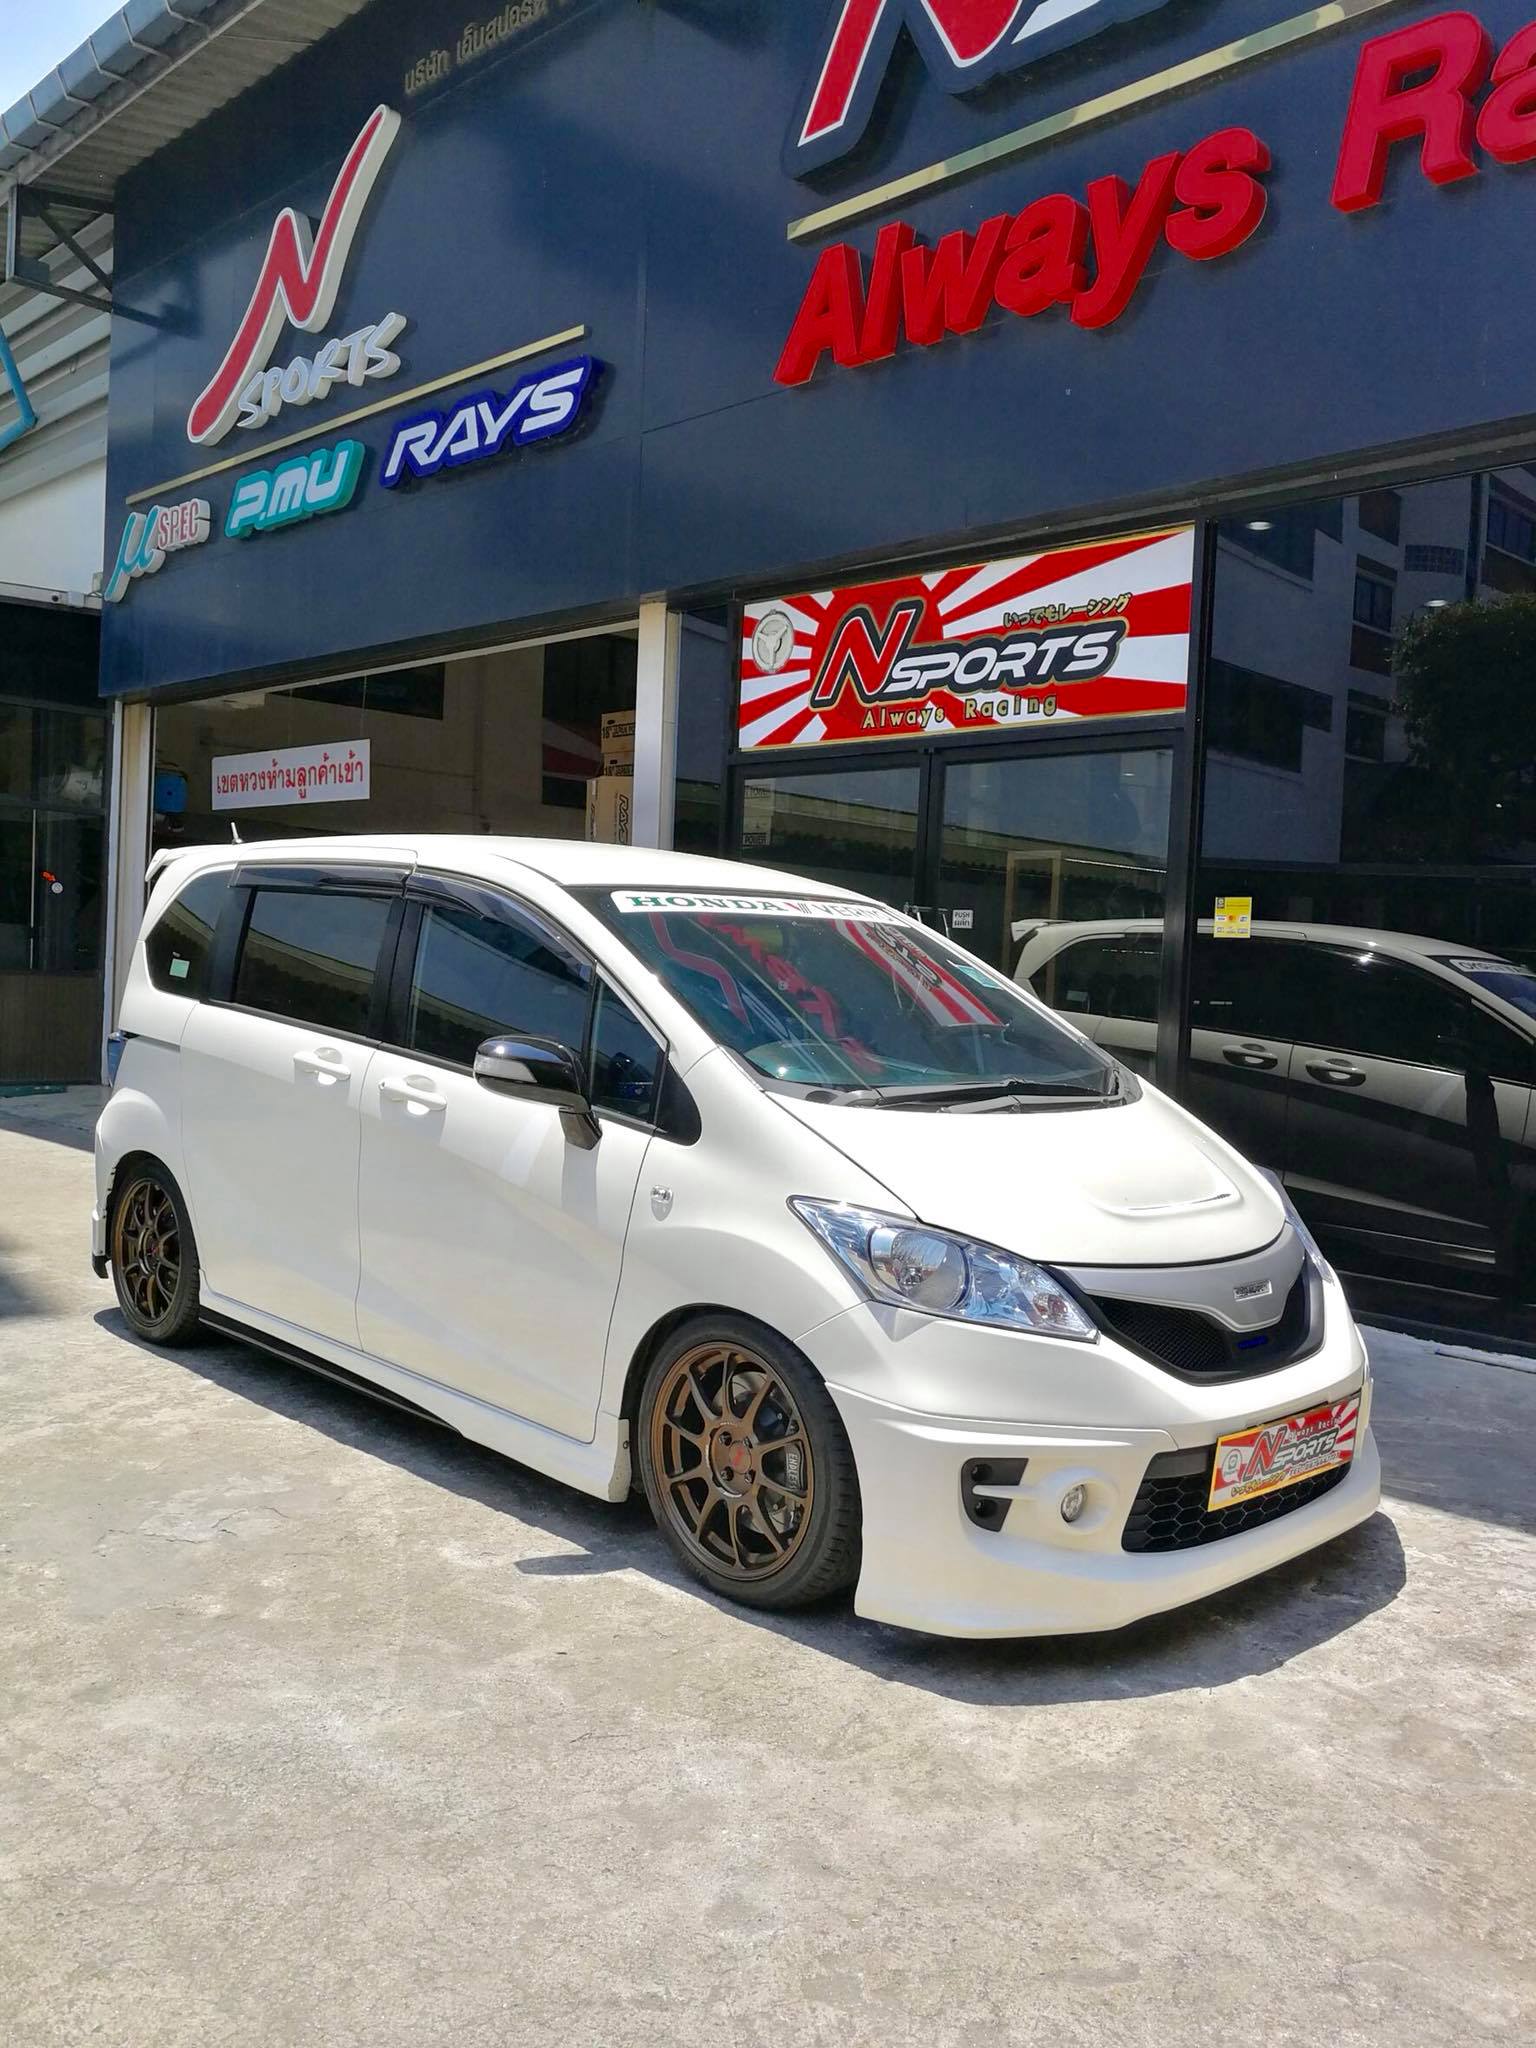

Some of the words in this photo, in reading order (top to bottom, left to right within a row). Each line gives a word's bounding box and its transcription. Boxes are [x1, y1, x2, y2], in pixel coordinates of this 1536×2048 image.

[772, 127, 1271, 387] Always
[237, 312, 407, 429] SPORTS
[385, 367, 585, 479] RAYS
[861, 706, 946, 731] Always
[964, 694, 1058, 719] Racing
[216, 750, 364, 799] เขตหวงห้ามลูกค้าเข้า
[625, 895, 786, 912] HONDA
